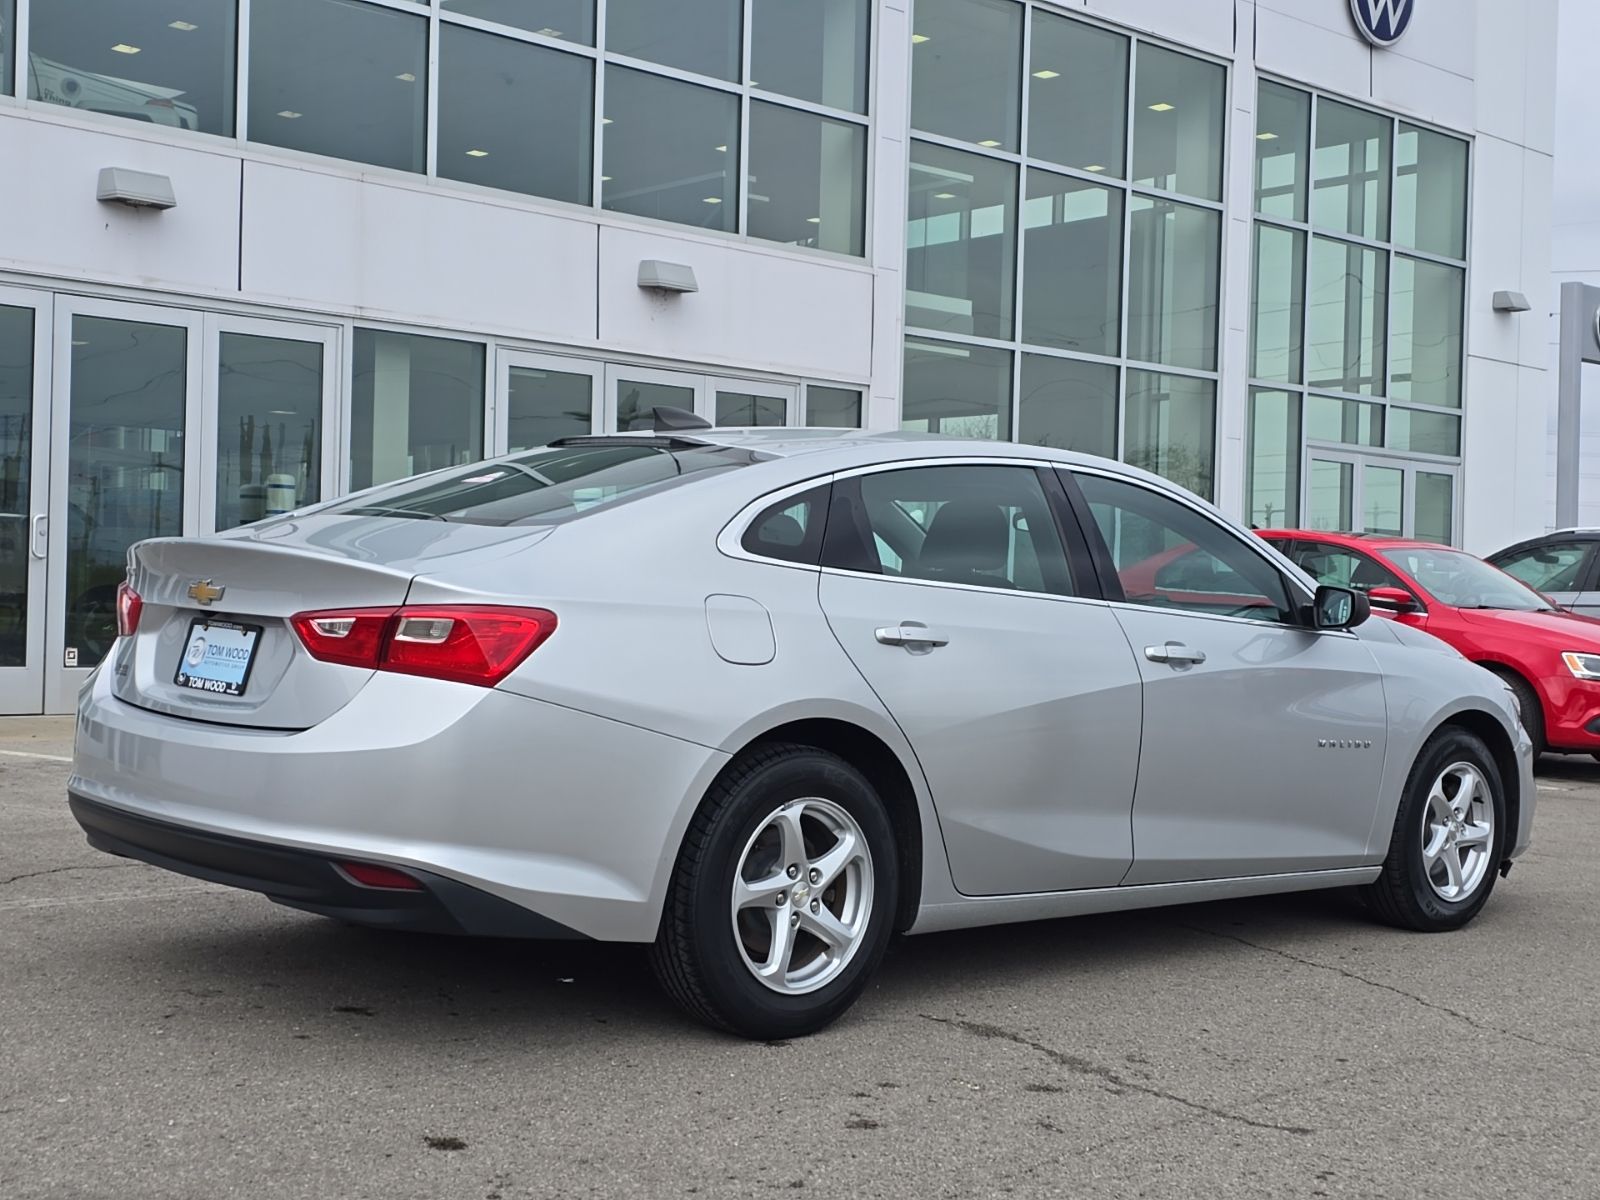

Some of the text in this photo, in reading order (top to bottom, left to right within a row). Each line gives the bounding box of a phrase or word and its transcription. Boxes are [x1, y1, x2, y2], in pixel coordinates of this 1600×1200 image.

[207, 644, 249, 660] TOM WOOD
[189, 676, 204, 689] TOM
[204, 679, 226, 692] WOOD
